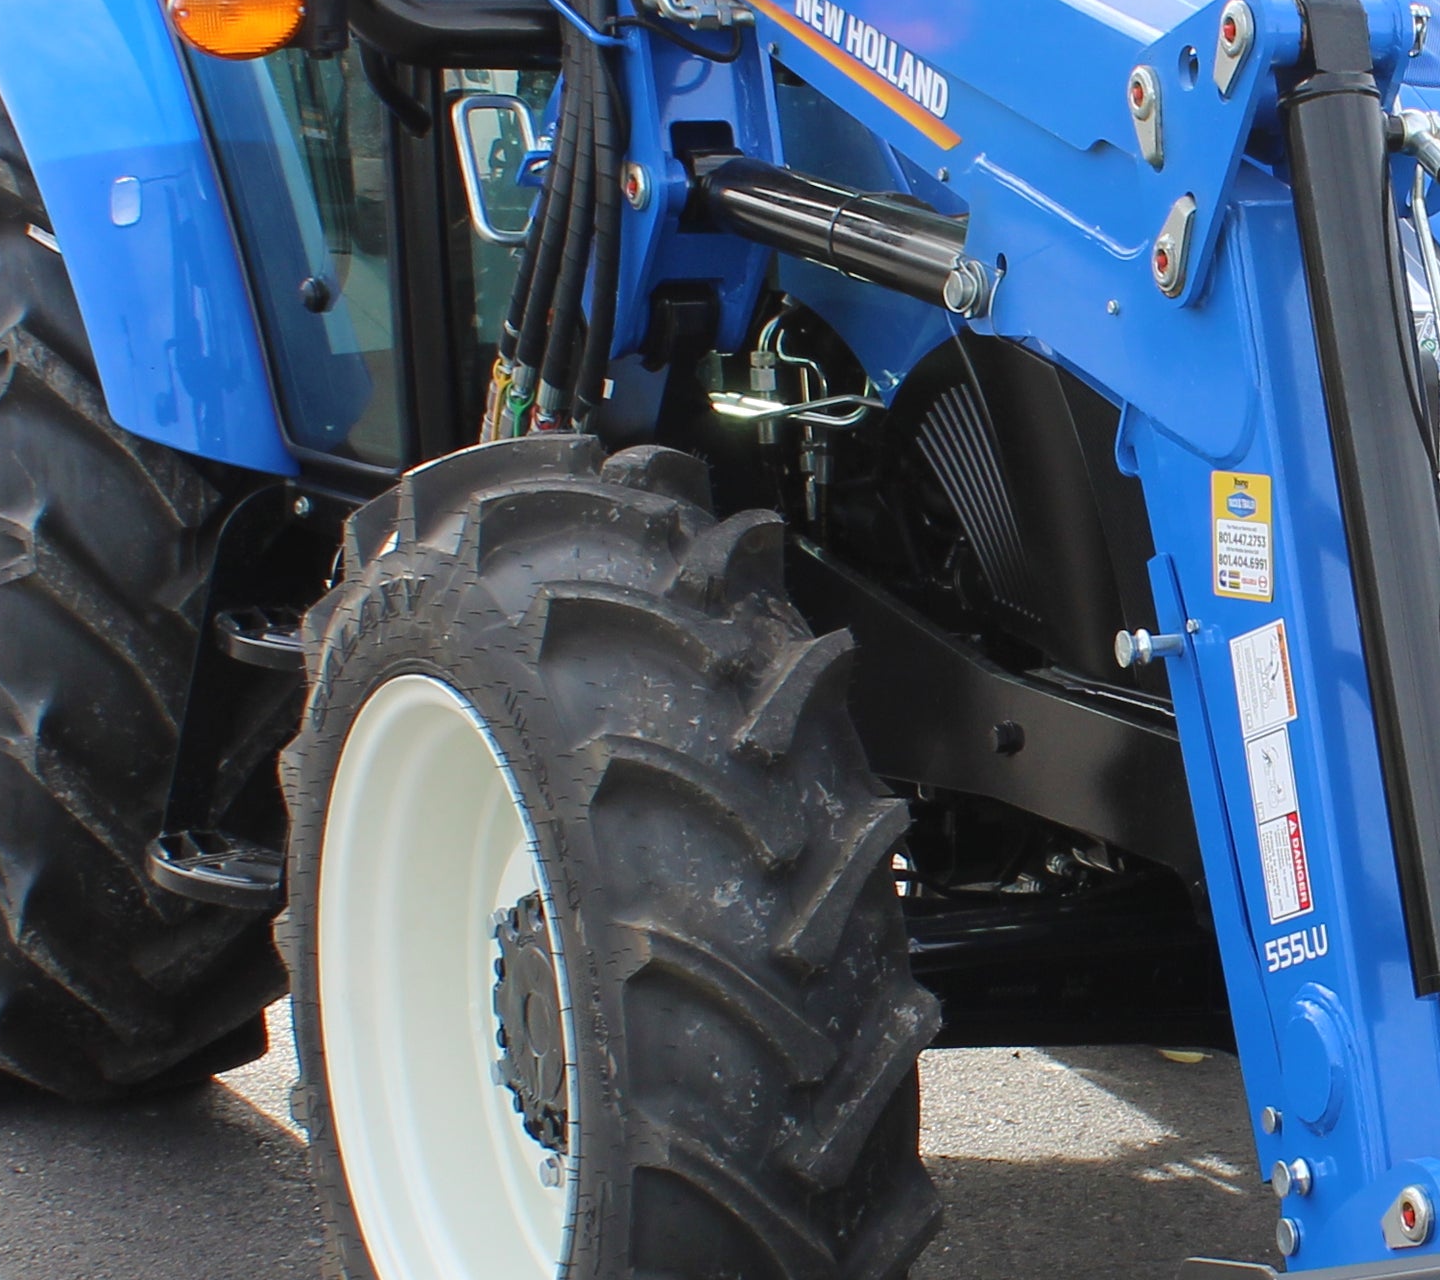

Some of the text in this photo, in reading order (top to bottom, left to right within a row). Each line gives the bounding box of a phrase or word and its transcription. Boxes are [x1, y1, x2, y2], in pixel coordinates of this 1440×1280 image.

[846, 14, 950, 121] HOLLAND
[1289, 837, 1308, 904] DANGER
[1264, 923, 1329, 973] 555LU
